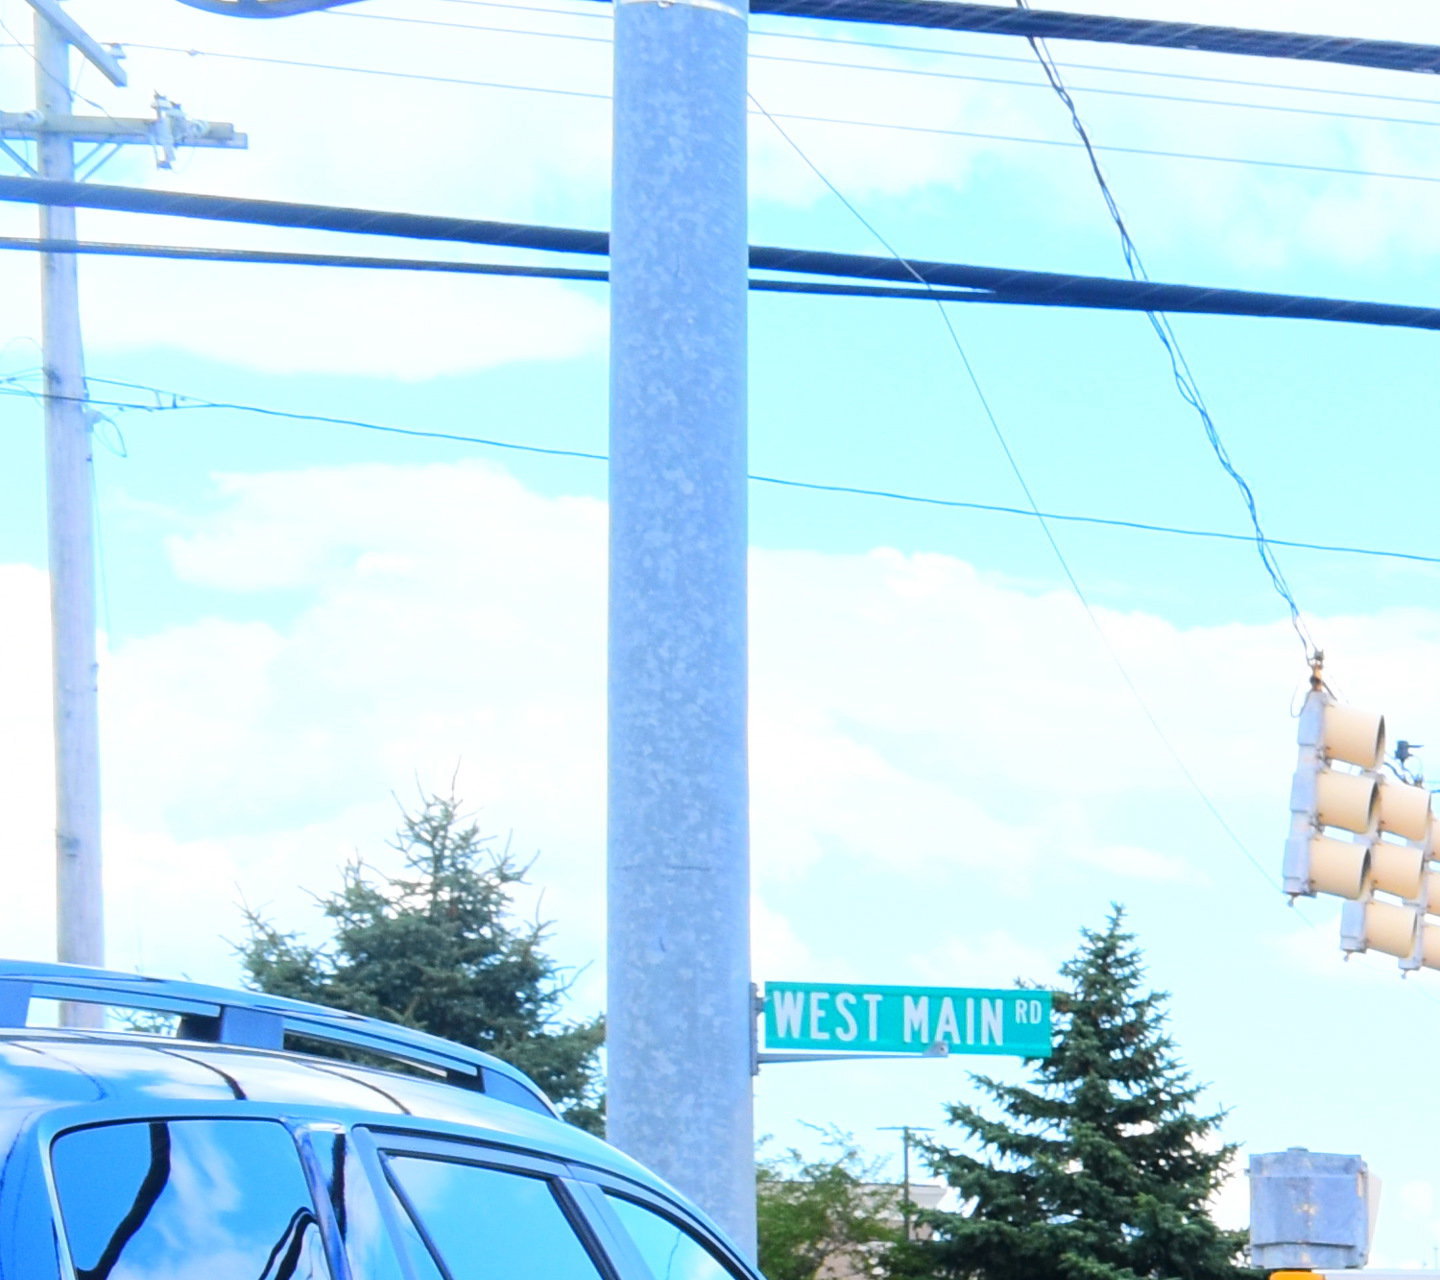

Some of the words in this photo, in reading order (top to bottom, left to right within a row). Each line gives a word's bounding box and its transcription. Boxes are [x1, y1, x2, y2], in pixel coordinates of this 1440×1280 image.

[773, 990, 883, 1042] WEST
[903, 995, 1004, 1046] MAIN
[1015, 999, 1042, 1025] RD
